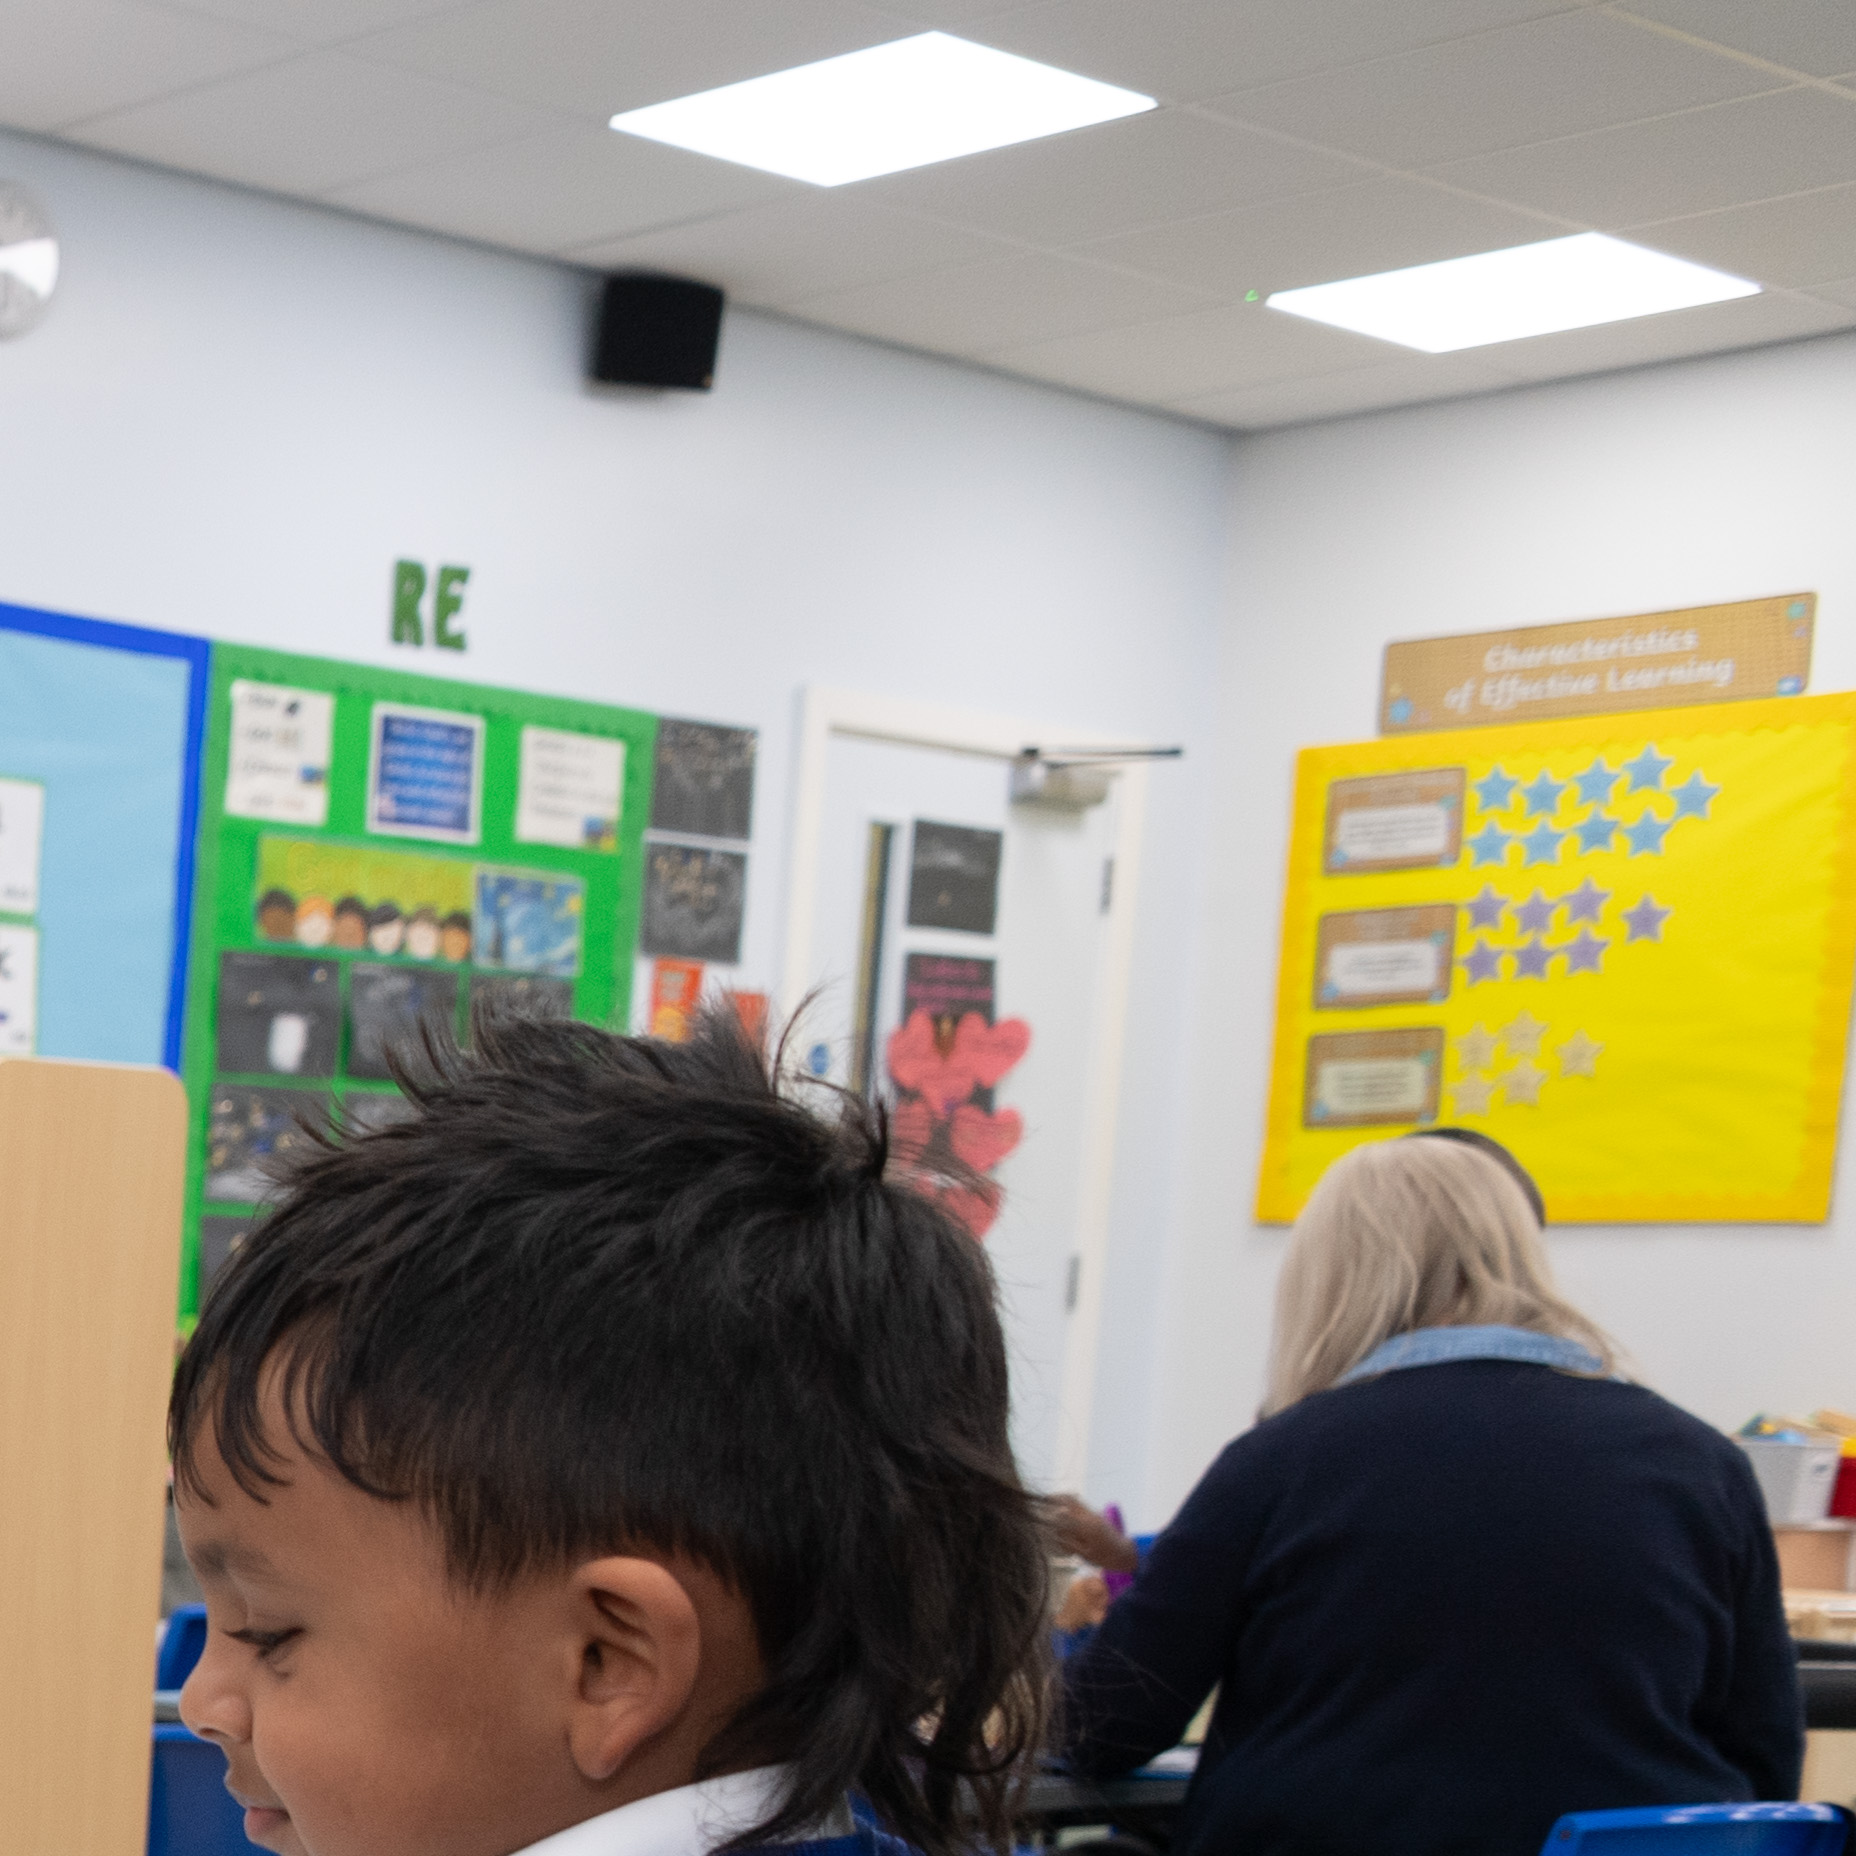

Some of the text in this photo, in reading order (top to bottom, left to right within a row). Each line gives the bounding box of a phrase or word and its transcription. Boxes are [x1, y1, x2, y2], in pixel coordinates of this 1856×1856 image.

[390, 557, 470, 650] RE
[1483, 626, 1699, 673] Characteristics
[1444, 654, 1735, 714] of Effective Learning
